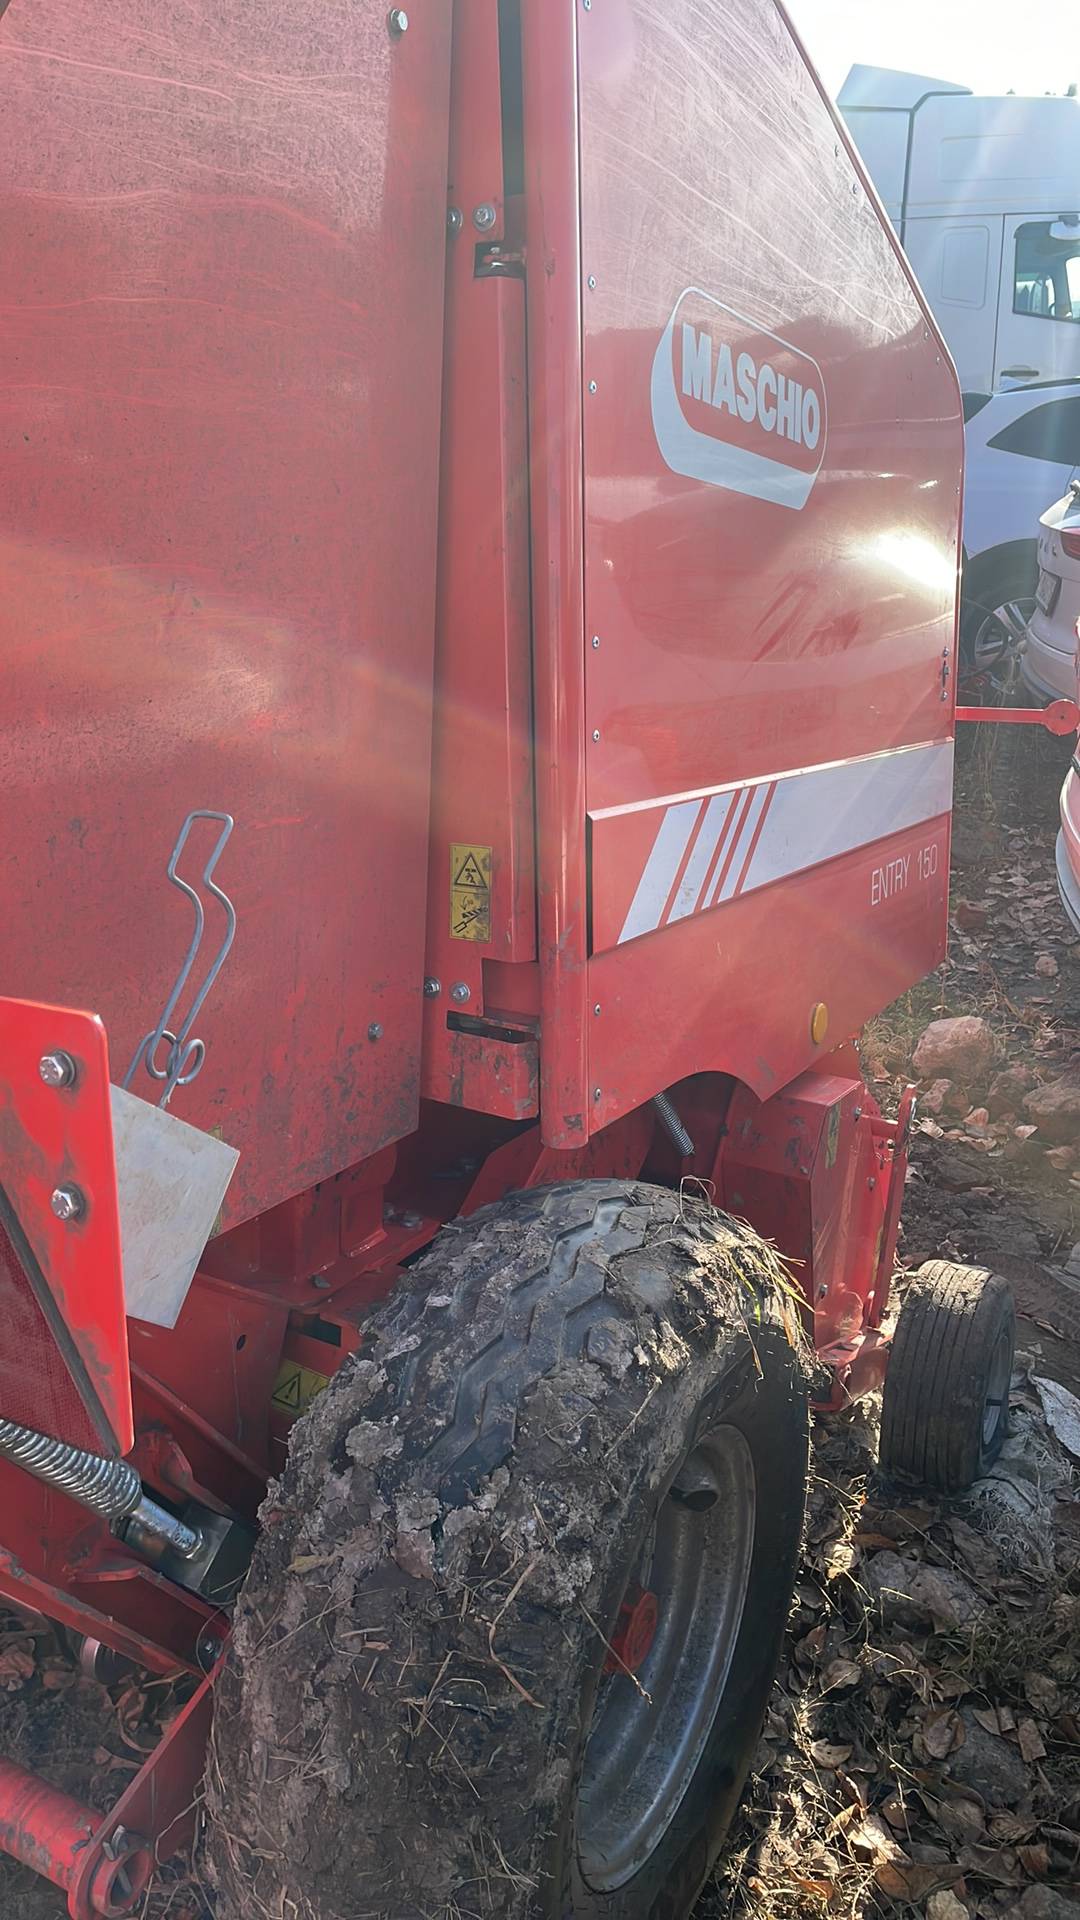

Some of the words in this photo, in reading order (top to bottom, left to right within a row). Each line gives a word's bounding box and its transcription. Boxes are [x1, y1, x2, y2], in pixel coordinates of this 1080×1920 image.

[681, 321, 821, 450] MASCHIO
[871, 854, 911, 906] ENTRY
[917, 844, 938, 881] 150
